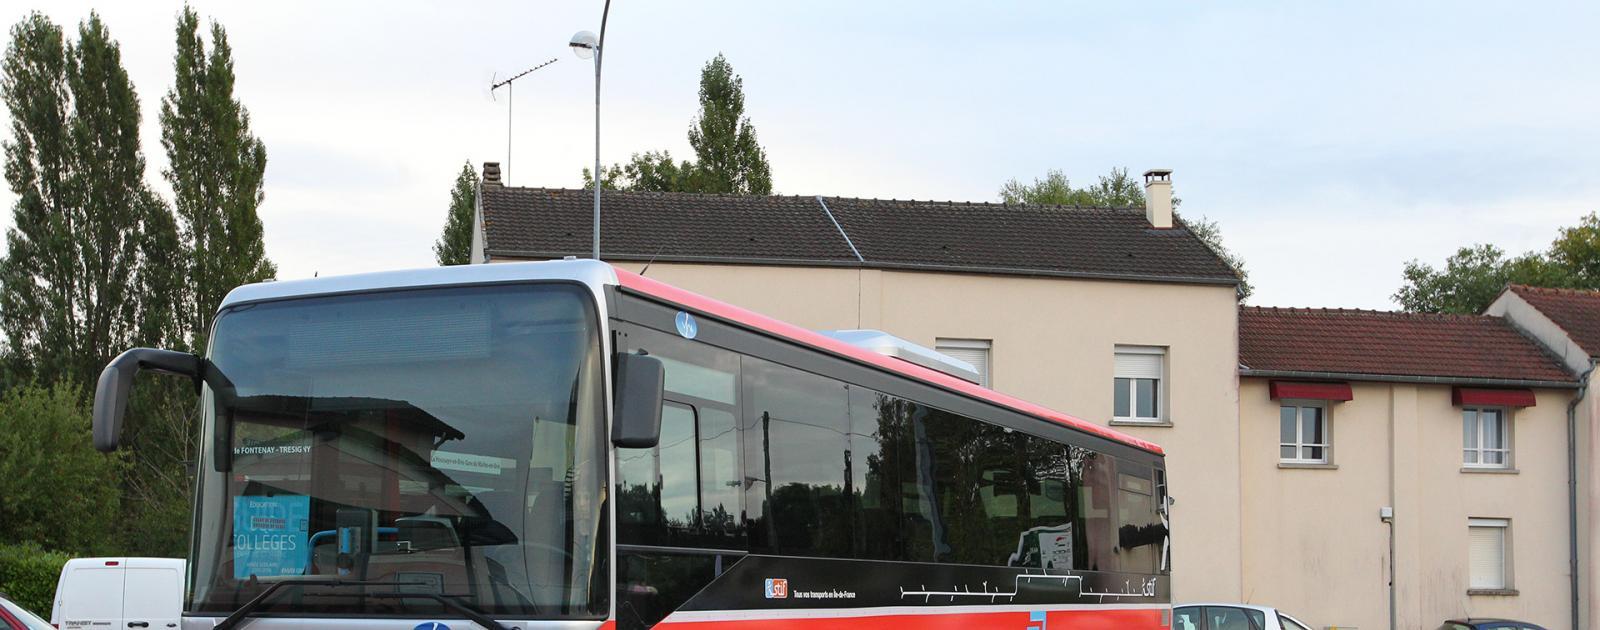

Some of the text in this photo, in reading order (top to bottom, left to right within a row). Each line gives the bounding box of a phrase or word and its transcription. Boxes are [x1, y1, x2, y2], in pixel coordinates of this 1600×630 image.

[241, 446, 275, 454] FONTENAY
[794, 590, 802, 598] Tous
[810, 590, 829, 600] transports
